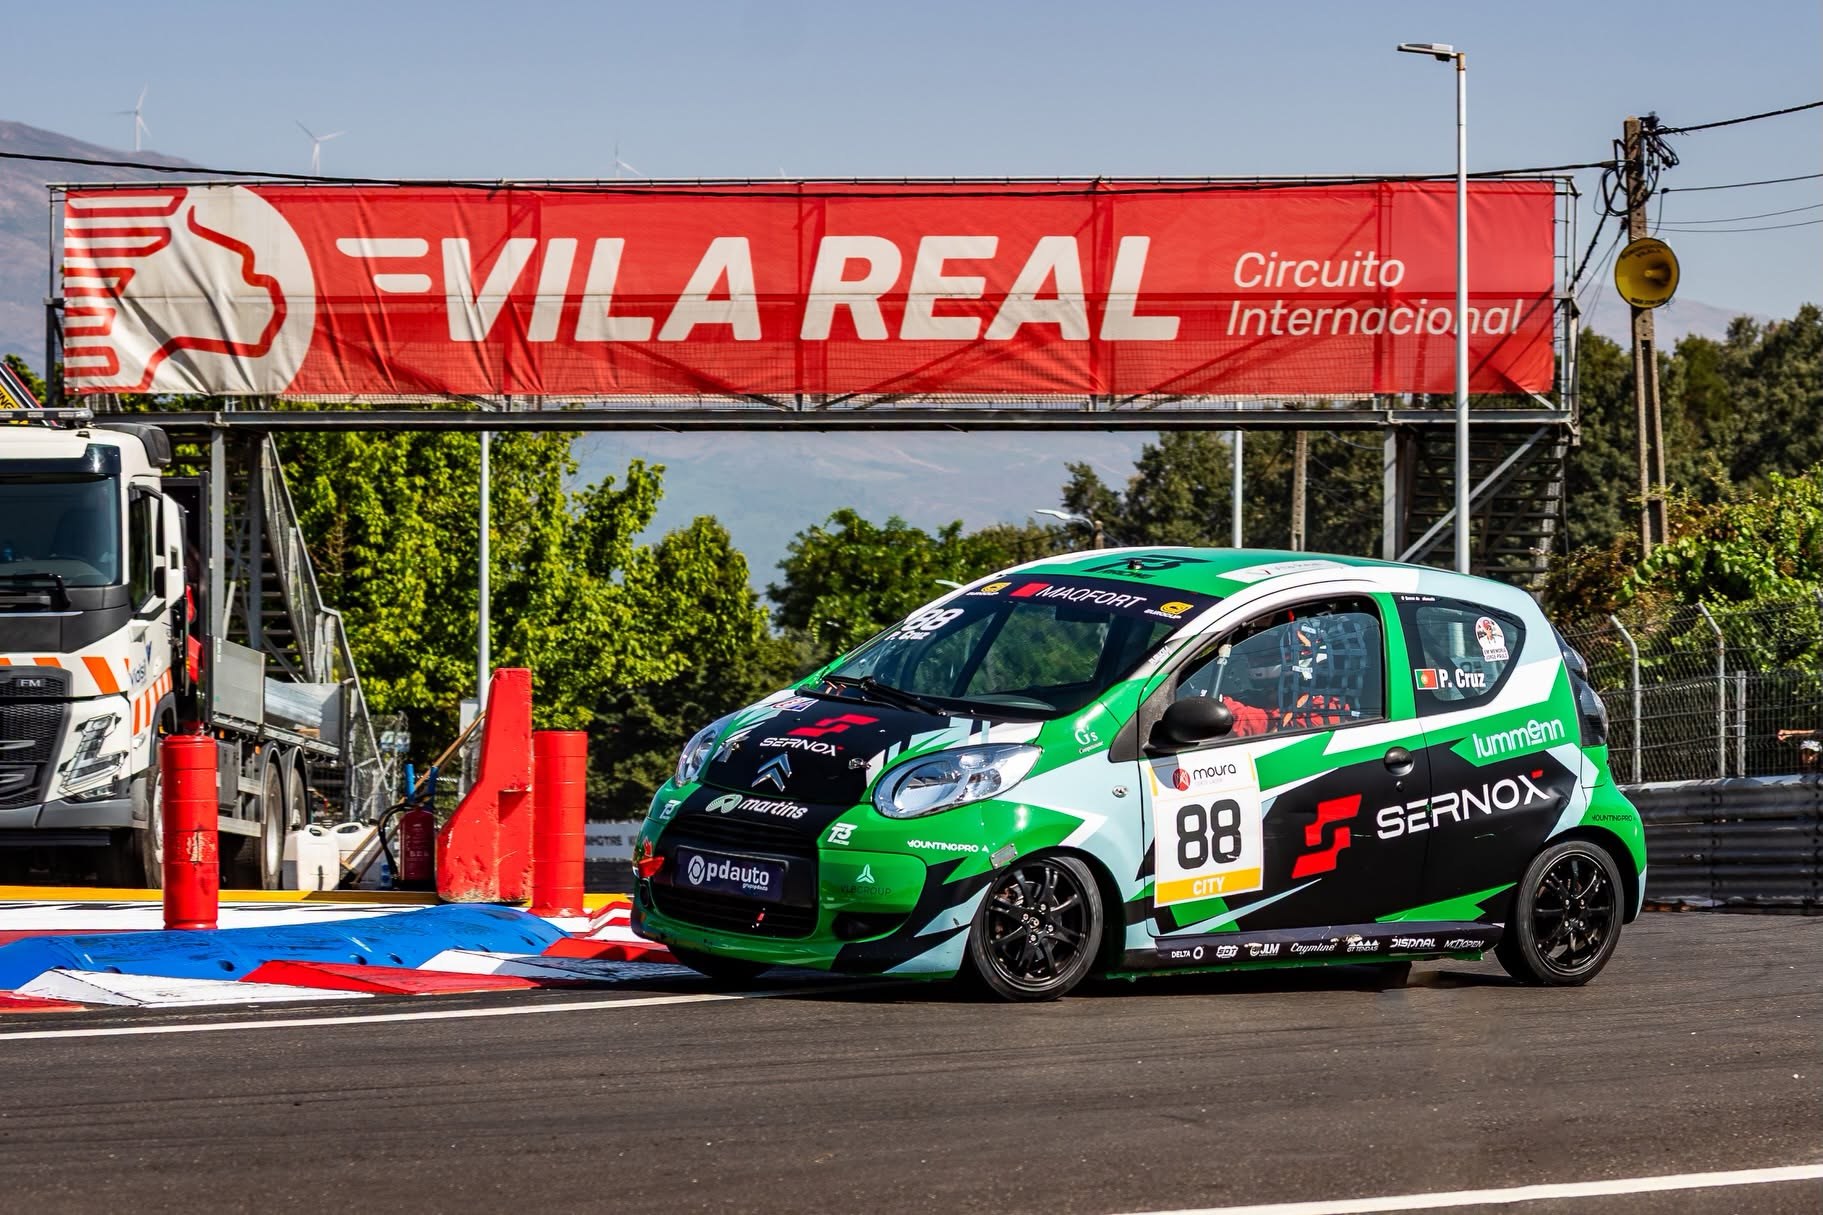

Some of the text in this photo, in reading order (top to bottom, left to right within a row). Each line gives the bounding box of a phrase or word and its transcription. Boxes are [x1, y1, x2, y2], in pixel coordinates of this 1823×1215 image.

[1233, 250, 1406, 288] Circuito
[441, 235, 1181, 342] VILA REAL
[1226, 298, 1523, 336] Internacional
[1036, 586, 1148, 609] MAQFORT
[901, 608, 965, 631] 88
[1438, 668, 1487, 688] P. Cruz
[760, 737, 845, 757] SERNOX
[1472, 719, 1565, 759] lummenn
[1193, 763, 1237, 780] moura
[738, 798, 808, 819] martins
[1376, 769, 1551, 840] SERNOX
[1176, 799, 1242, 870] 88
[706, 859, 770, 886] pdauto
[1193, 877, 1225, 896] CITY
[1171, 950, 1191, 958] DELTA
